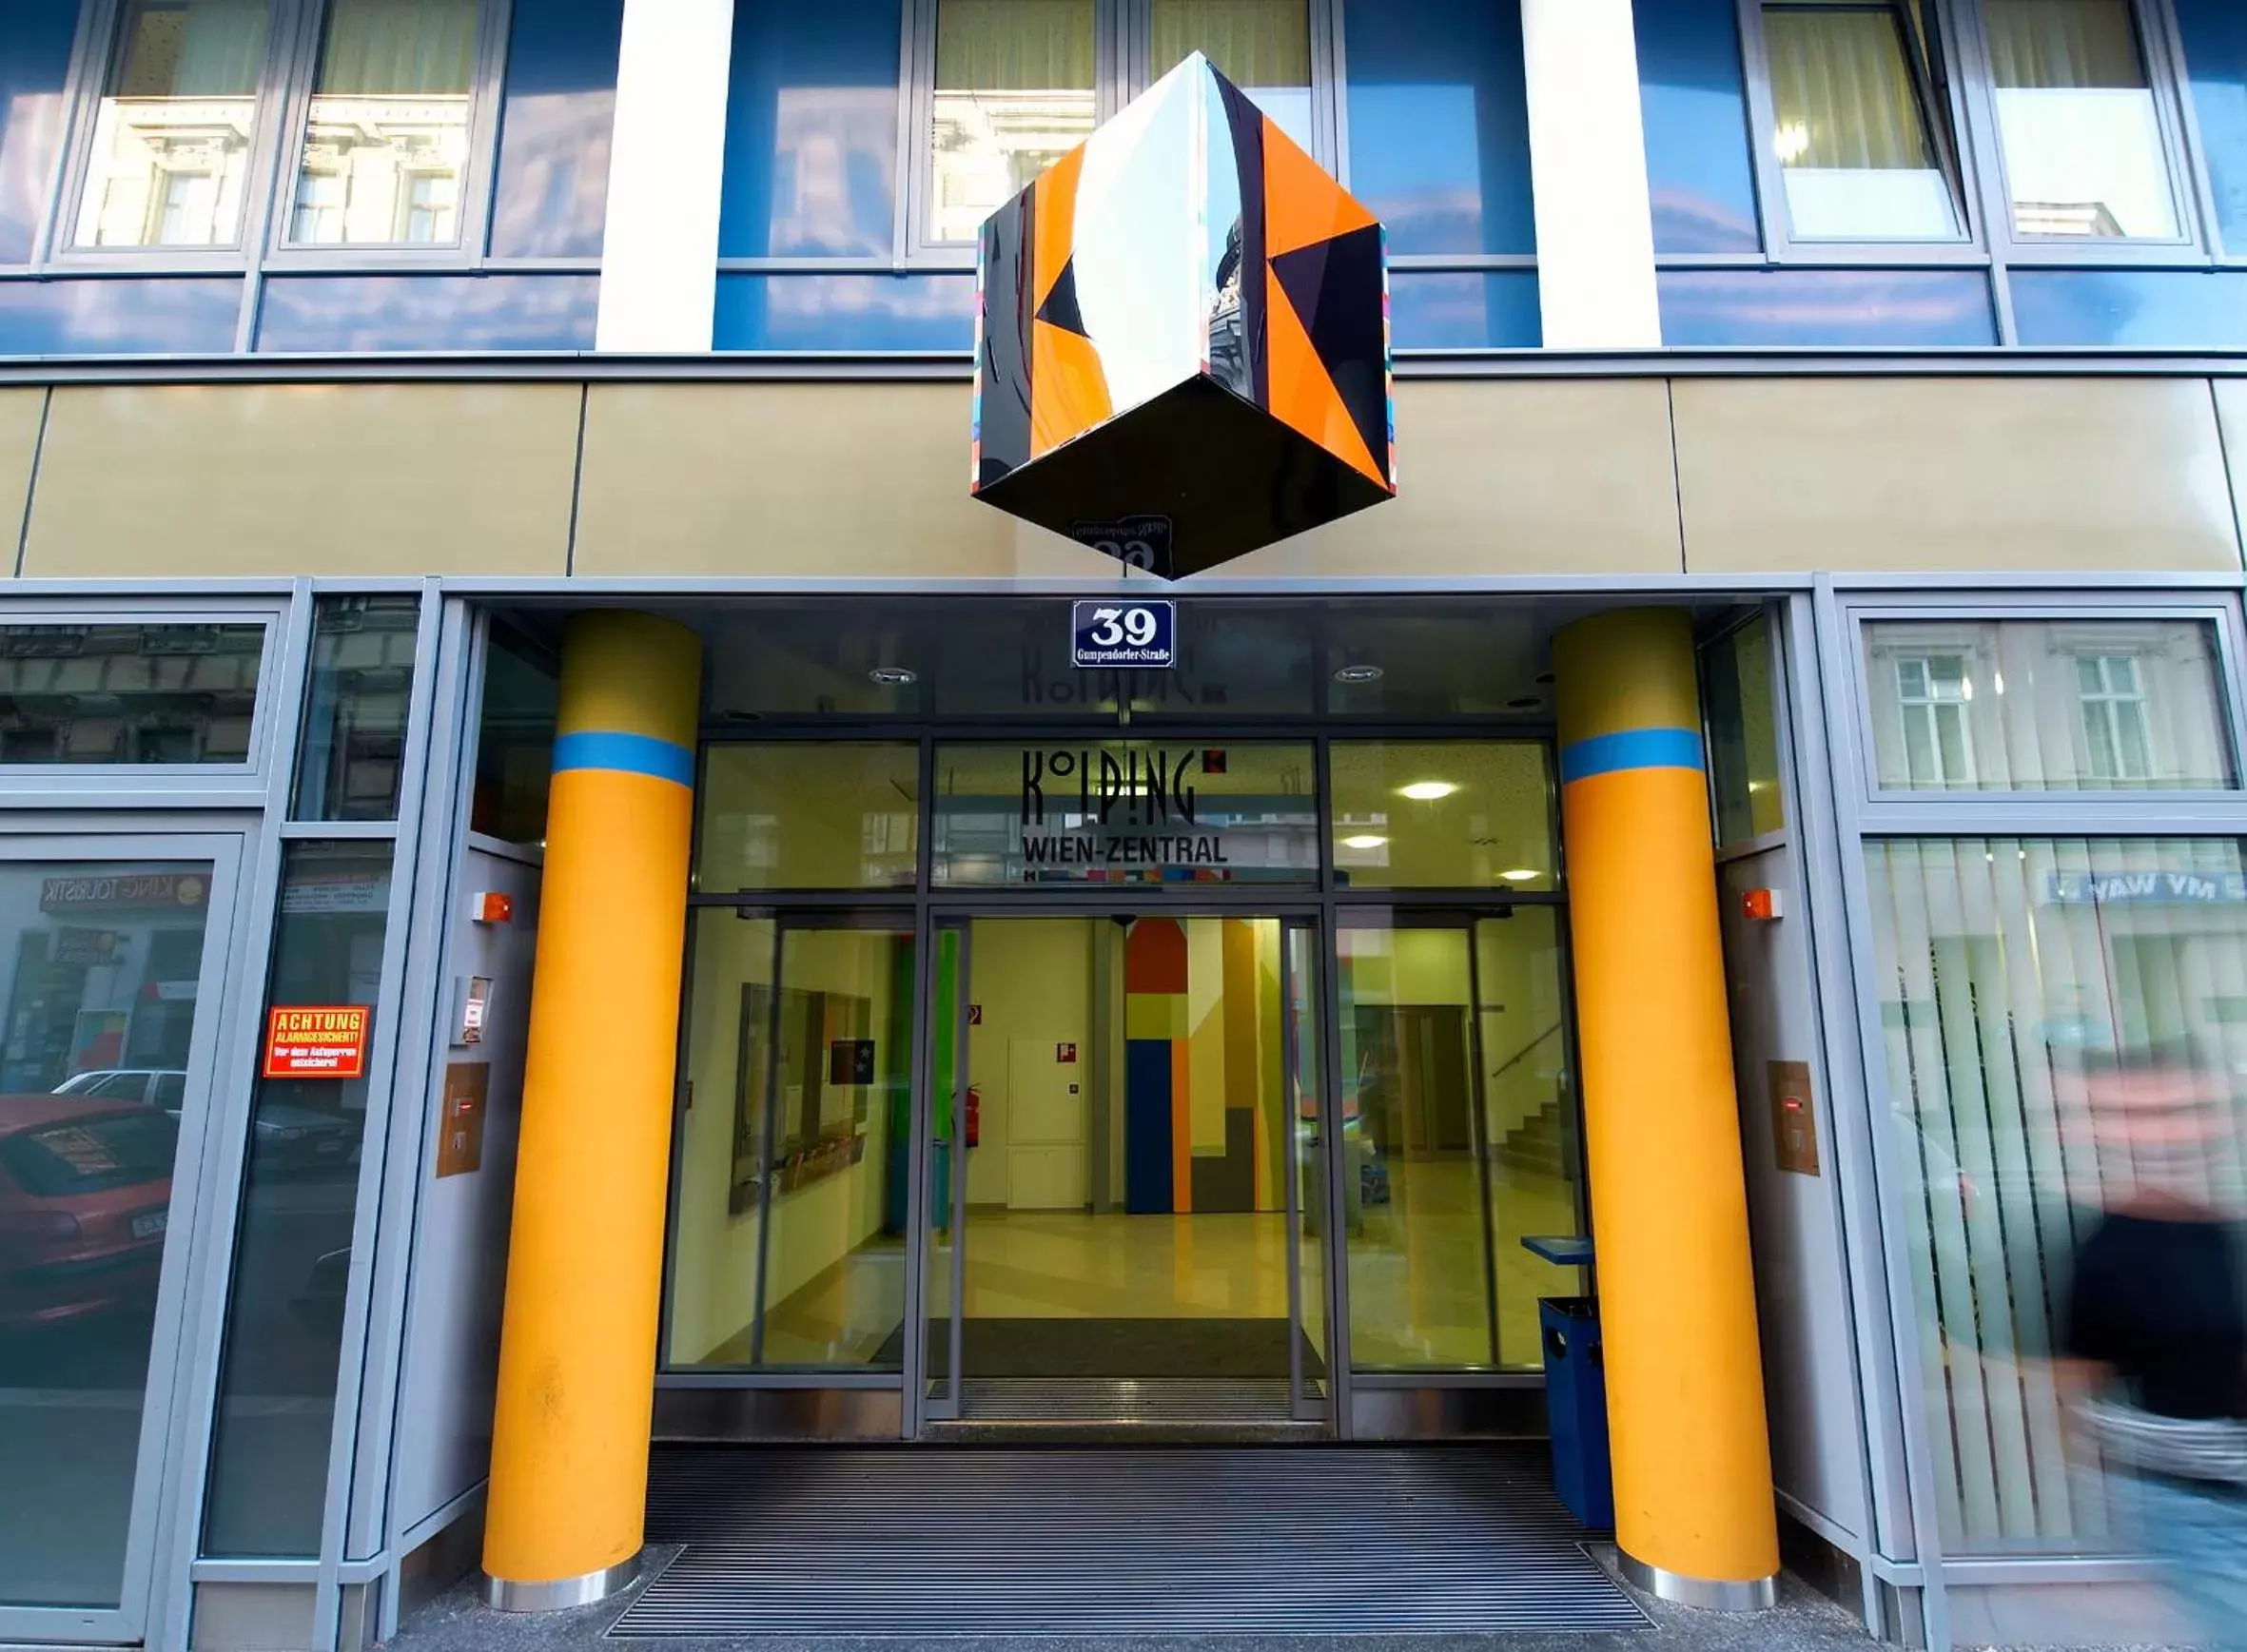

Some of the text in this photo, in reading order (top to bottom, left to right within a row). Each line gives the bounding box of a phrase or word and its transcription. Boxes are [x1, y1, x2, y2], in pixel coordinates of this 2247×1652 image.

[1091, 608, 1157, 646] 39
[1023, 836, 1228, 863] WIEN-ZENTRAL
[277, 1013, 361, 1030] ACHTUNG
